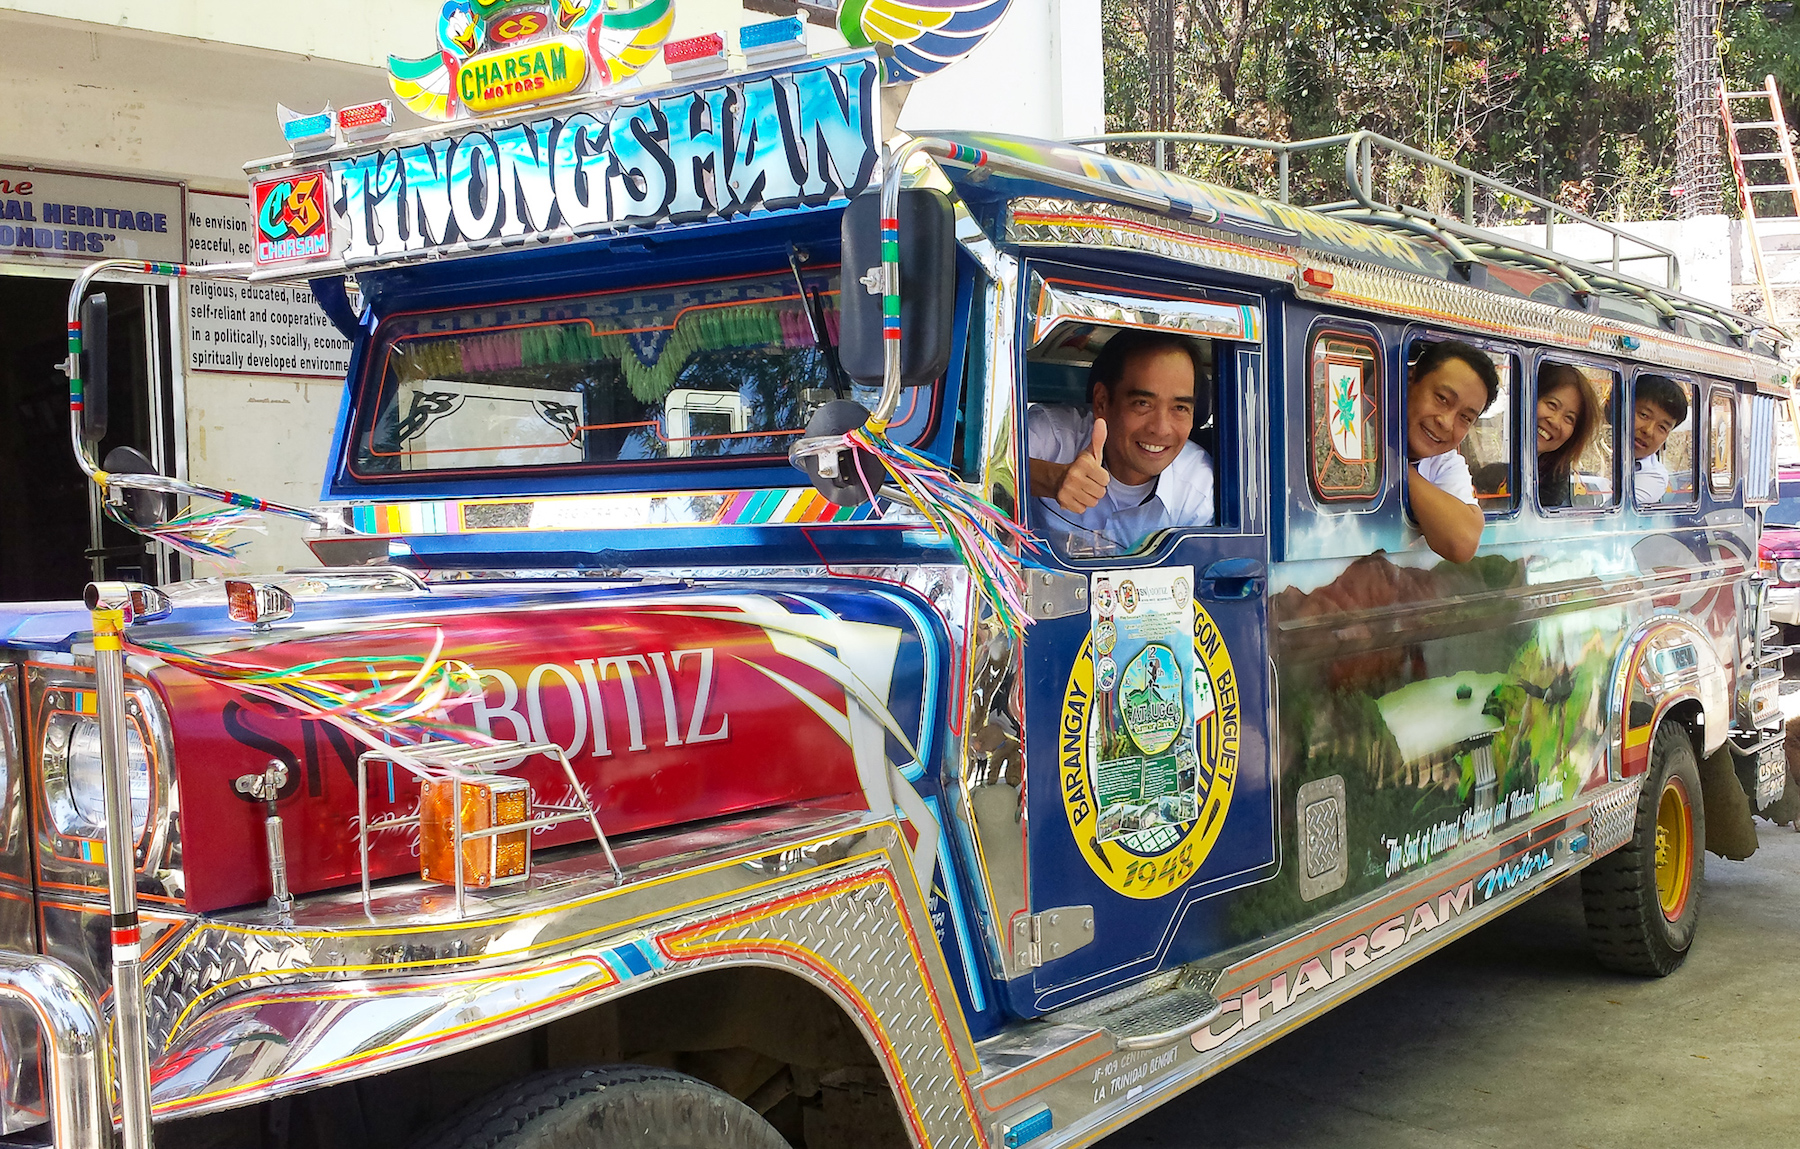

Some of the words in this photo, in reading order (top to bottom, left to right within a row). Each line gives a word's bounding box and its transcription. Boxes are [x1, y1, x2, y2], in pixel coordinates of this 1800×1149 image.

[498, 15, 540, 39] CS
[461, 46, 567, 101] CHARSAM
[483, 77, 545, 100] MOTORS
[0, 199, 37, 222] AL
[42, 202, 168, 234] HERITAGE
[259, 176, 323, 239] CS
[205, 215, 248, 232] envision
[259, 234, 327, 260] CHARSAM
[190, 281, 238, 301] religious,
[240, 285, 290, 305] educated,
[190, 305, 247, 322] self-reliant
[249, 309, 268, 323] and
[270, 312, 328, 329] cooperative
[191, 326, 202, 342] in
[204, 330, 211, 342] a
[213, 329, 268, 349] politically,
[269, 332, 312, 351] socially,
[191, 351, 245, 369] spiritually
[246, 354, 298, 371] developed
[1216, 668, 1239, 792] BENGUET
[1063, 678, 1092, 828] BARANGAY
[1402, 829, 1421, 869] Seat
[1420, 826, 1431, 865] of
[1430, 814, 1461, 856] Cultural
[1461, 803, 1493, 844] Heritage
[1493, 793, 1509, 828] and
[1509, 784, 1538, 820] Natural
[1122, 842, 1195, 892] 1948
[1189, 879, 1474, 1053] CHARSAM
[1477, 847, 1554, 893] Motors
[1091, 1059, 1119, 1084] JF-109
[1093, 1085, 1107, 1105] LA
[1110, 1062, 1149, 1096] TRINIDAD
[1149, 1045, 1179, 1075] BENGUET
